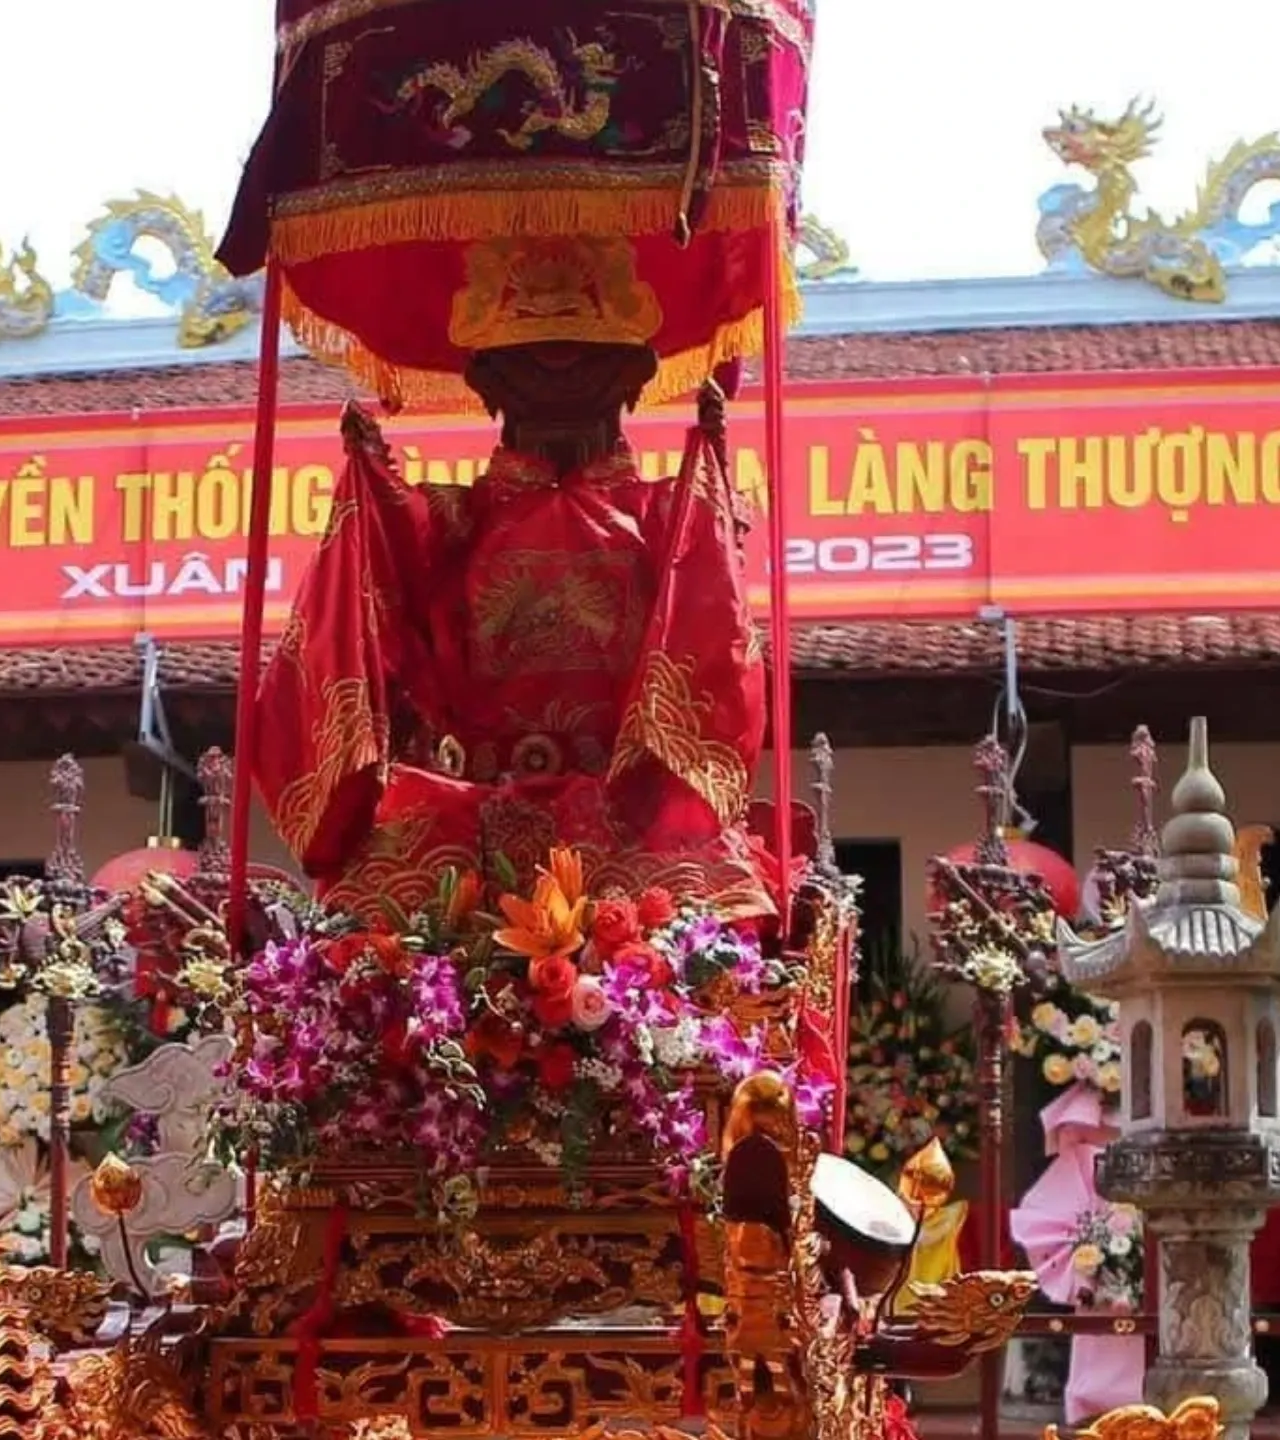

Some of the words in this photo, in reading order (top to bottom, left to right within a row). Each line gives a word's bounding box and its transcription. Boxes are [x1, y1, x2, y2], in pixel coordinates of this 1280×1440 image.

[807, 427, 995, 517] LÀNG
[60, 549, 284, 600] XUÂN
[767, 533, 975, 575] 2023
